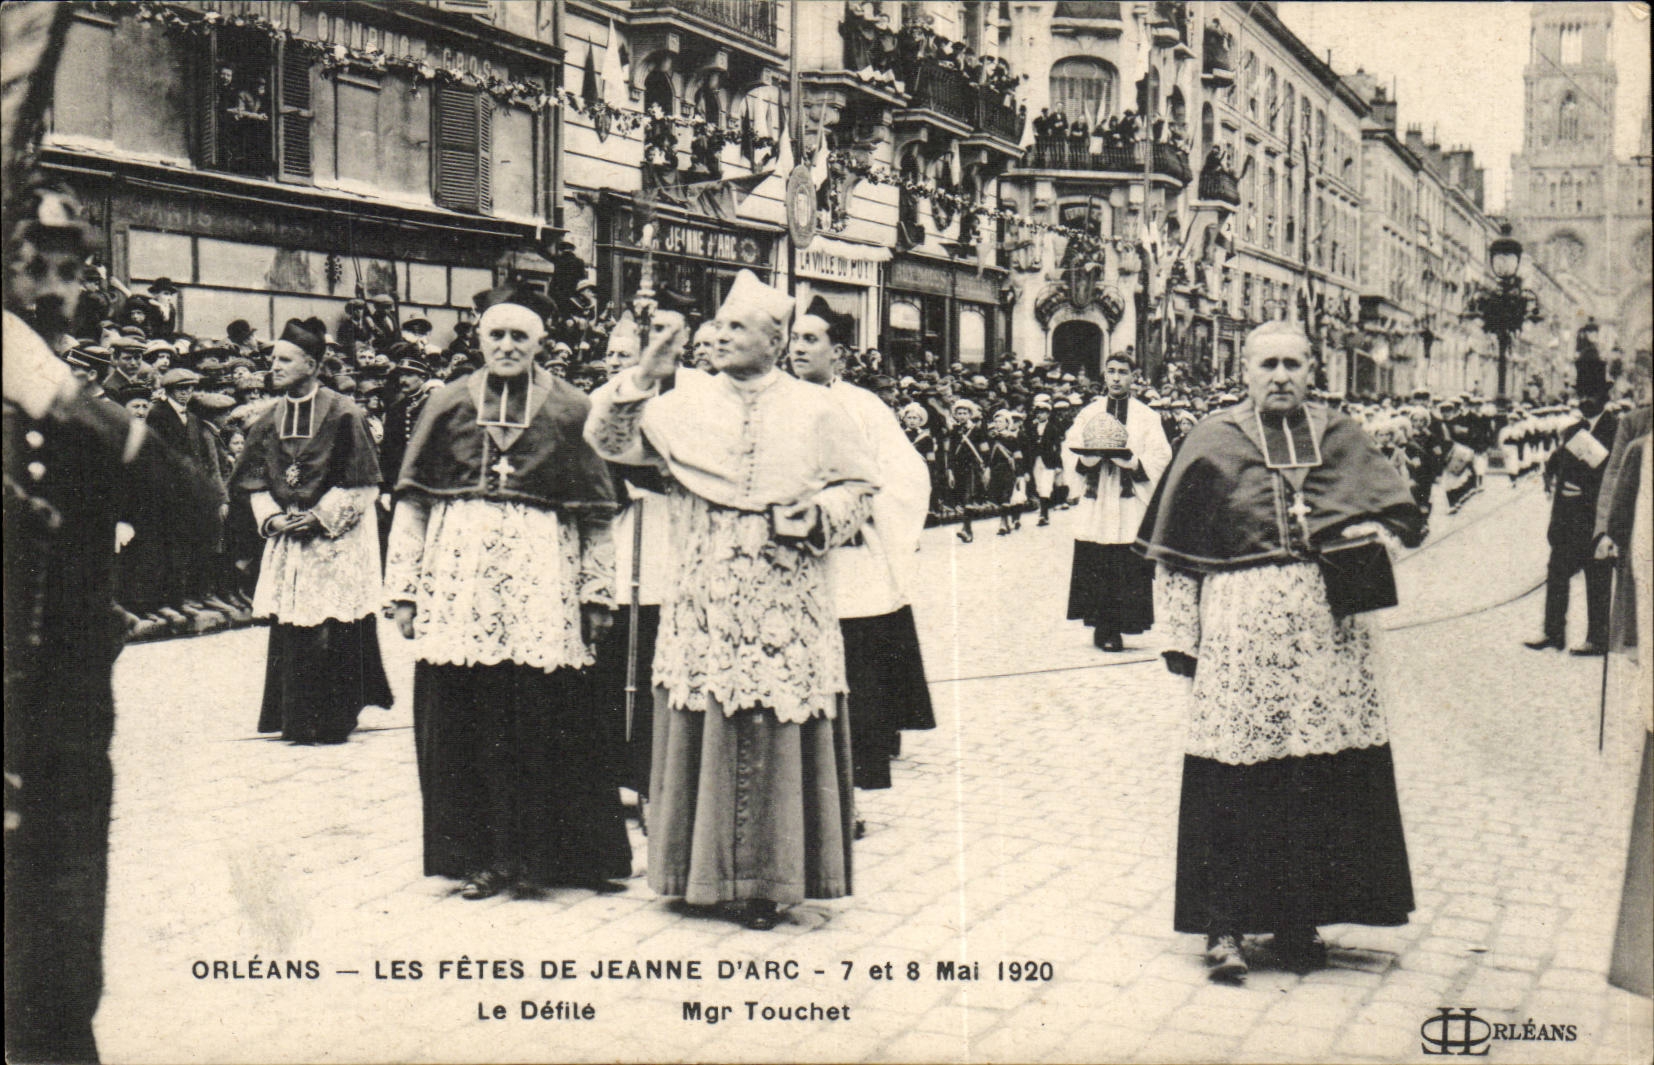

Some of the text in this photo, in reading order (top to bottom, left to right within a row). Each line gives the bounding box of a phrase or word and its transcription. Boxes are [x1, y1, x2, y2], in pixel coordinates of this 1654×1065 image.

[800, 251, 810, 271] LA
[812, 251, 834, 275] VILLE
[837, 256, 847, 277] DU
